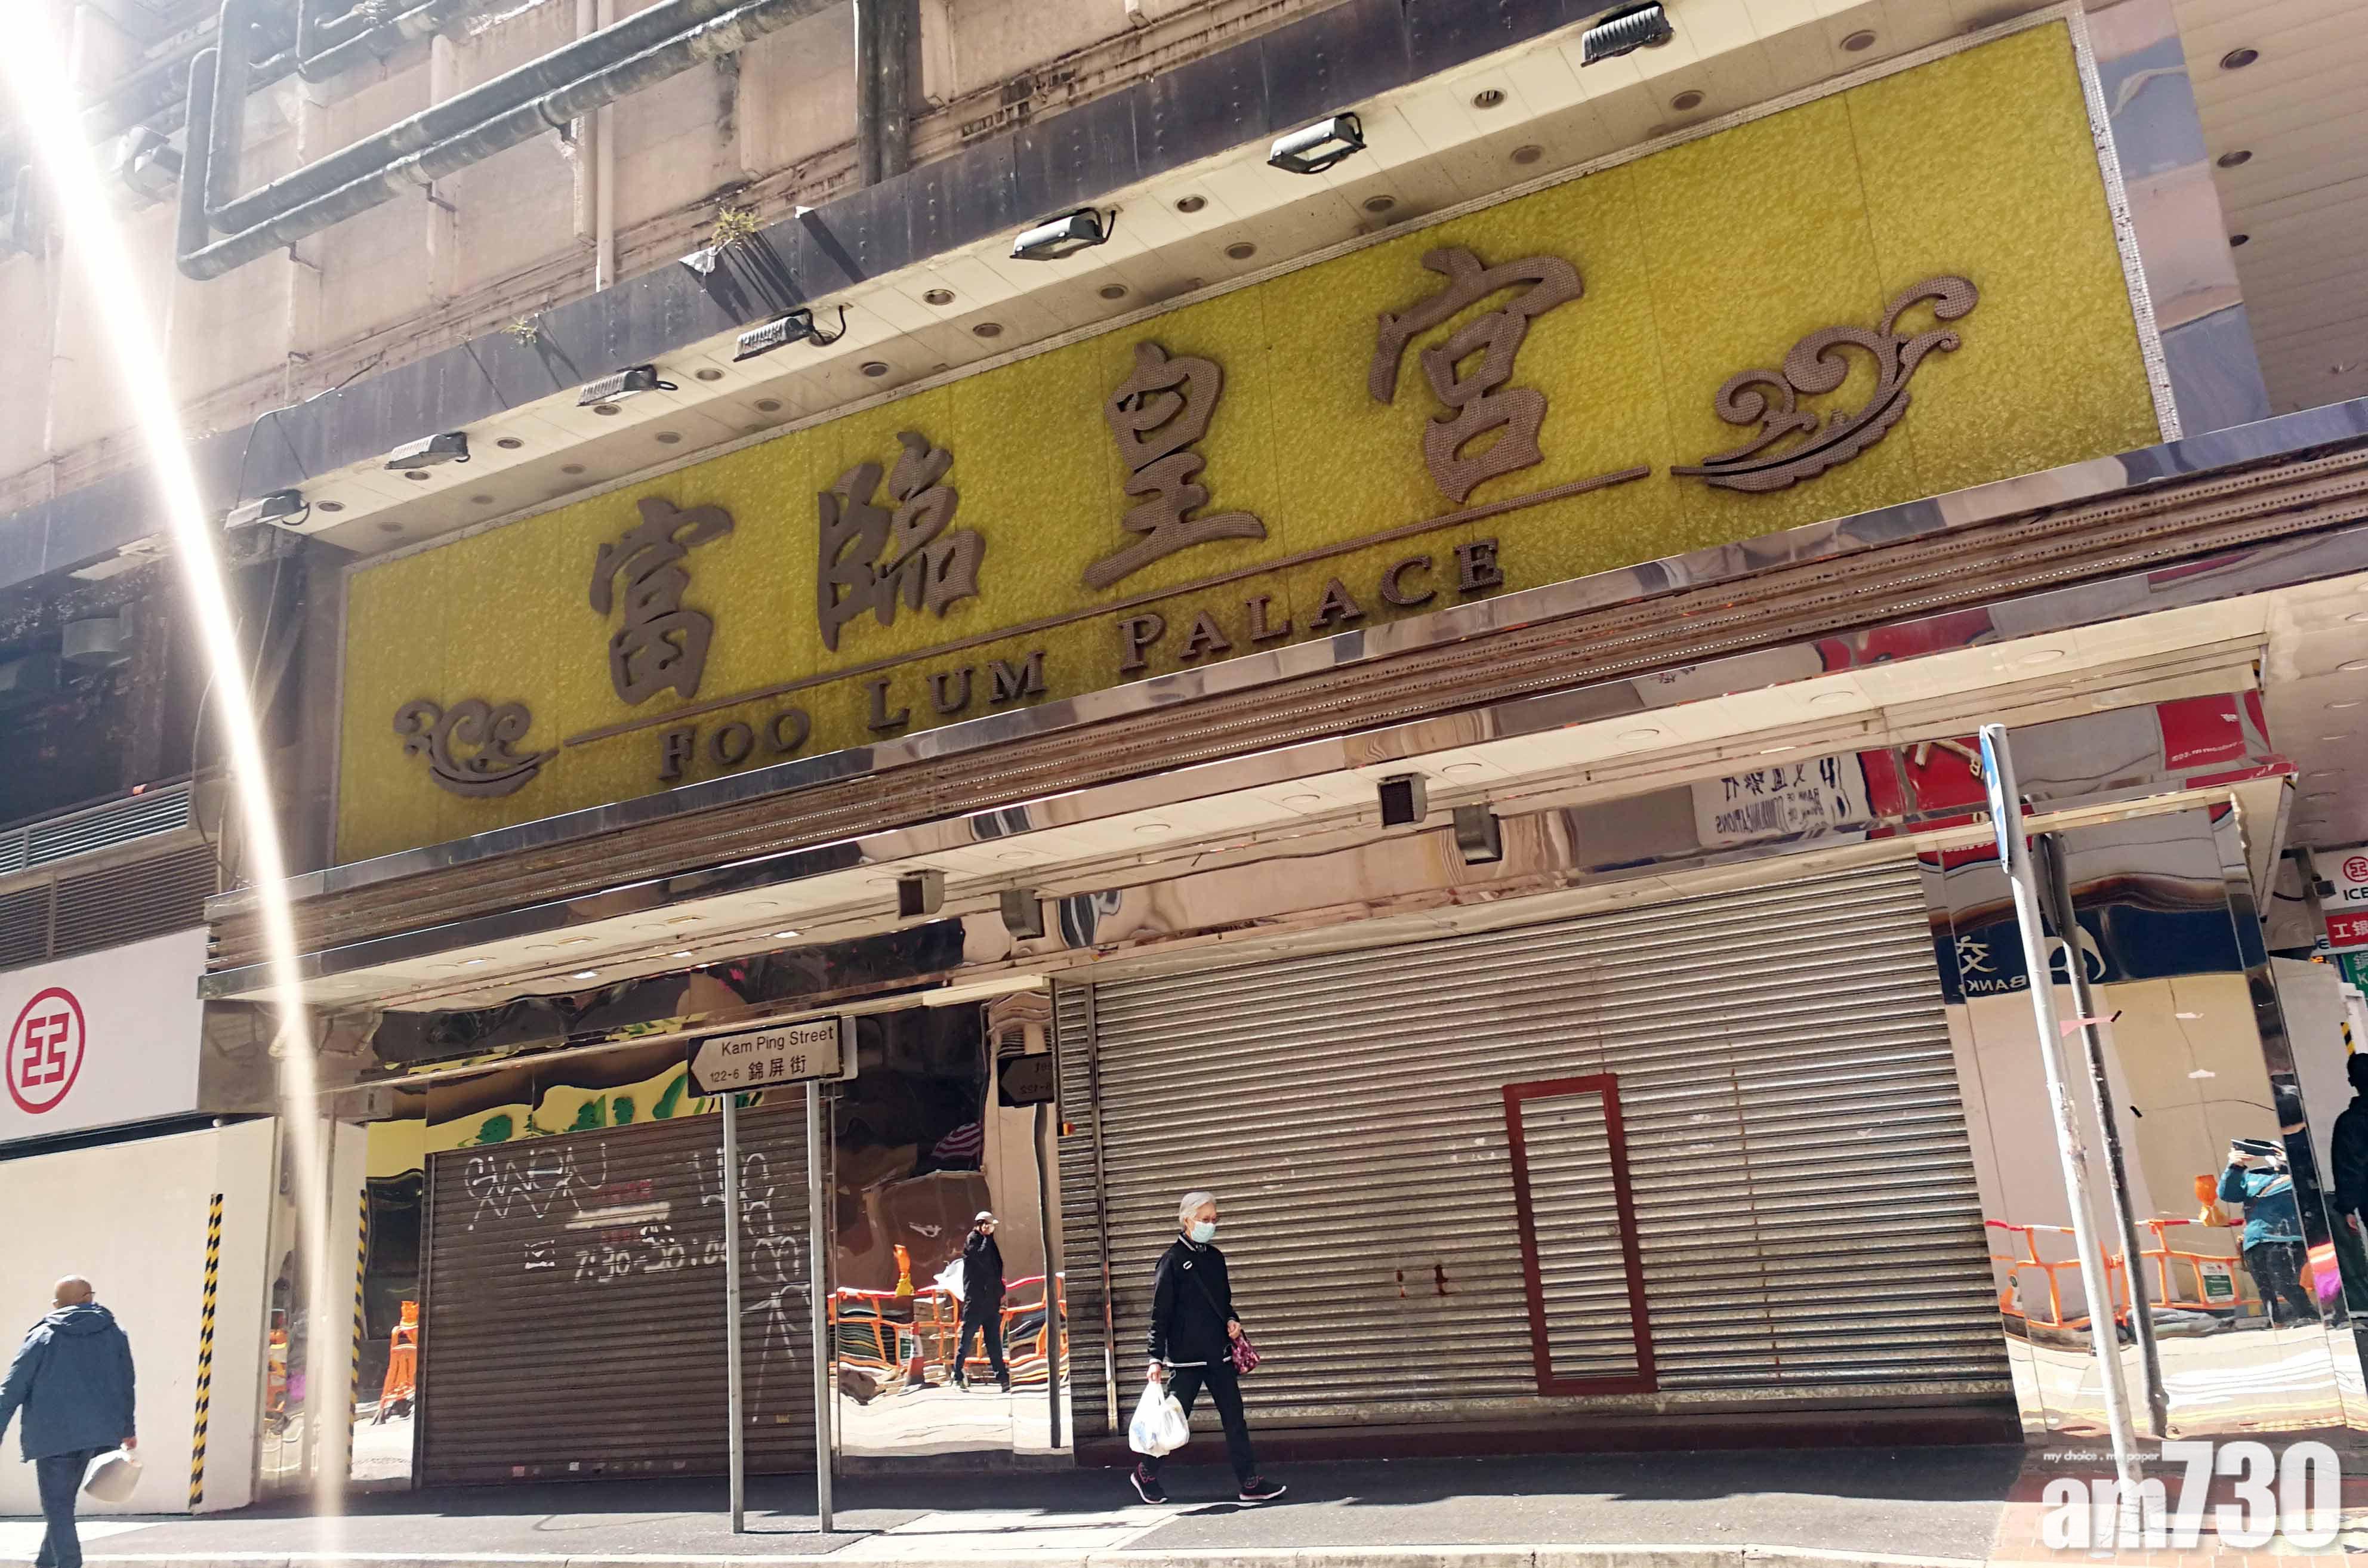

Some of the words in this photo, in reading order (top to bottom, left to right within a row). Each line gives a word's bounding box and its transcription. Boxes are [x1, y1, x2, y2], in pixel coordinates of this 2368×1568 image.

[589, 248, 1585, 706] 富臨皇宮
[658, 708, 811, 780] FOO
[865, 650, 1047, 731] LUM
[1117, 537, 1504, 674] PALACE
[710, 1069, 740, 1083] 122-6
[748, 1055, 807, 1081] 錦屏街
[722, 1041, 753, 1057] Kam
[757, 1036, 785, 1051] Ping
[789, 1026, 834, 1045] Street
